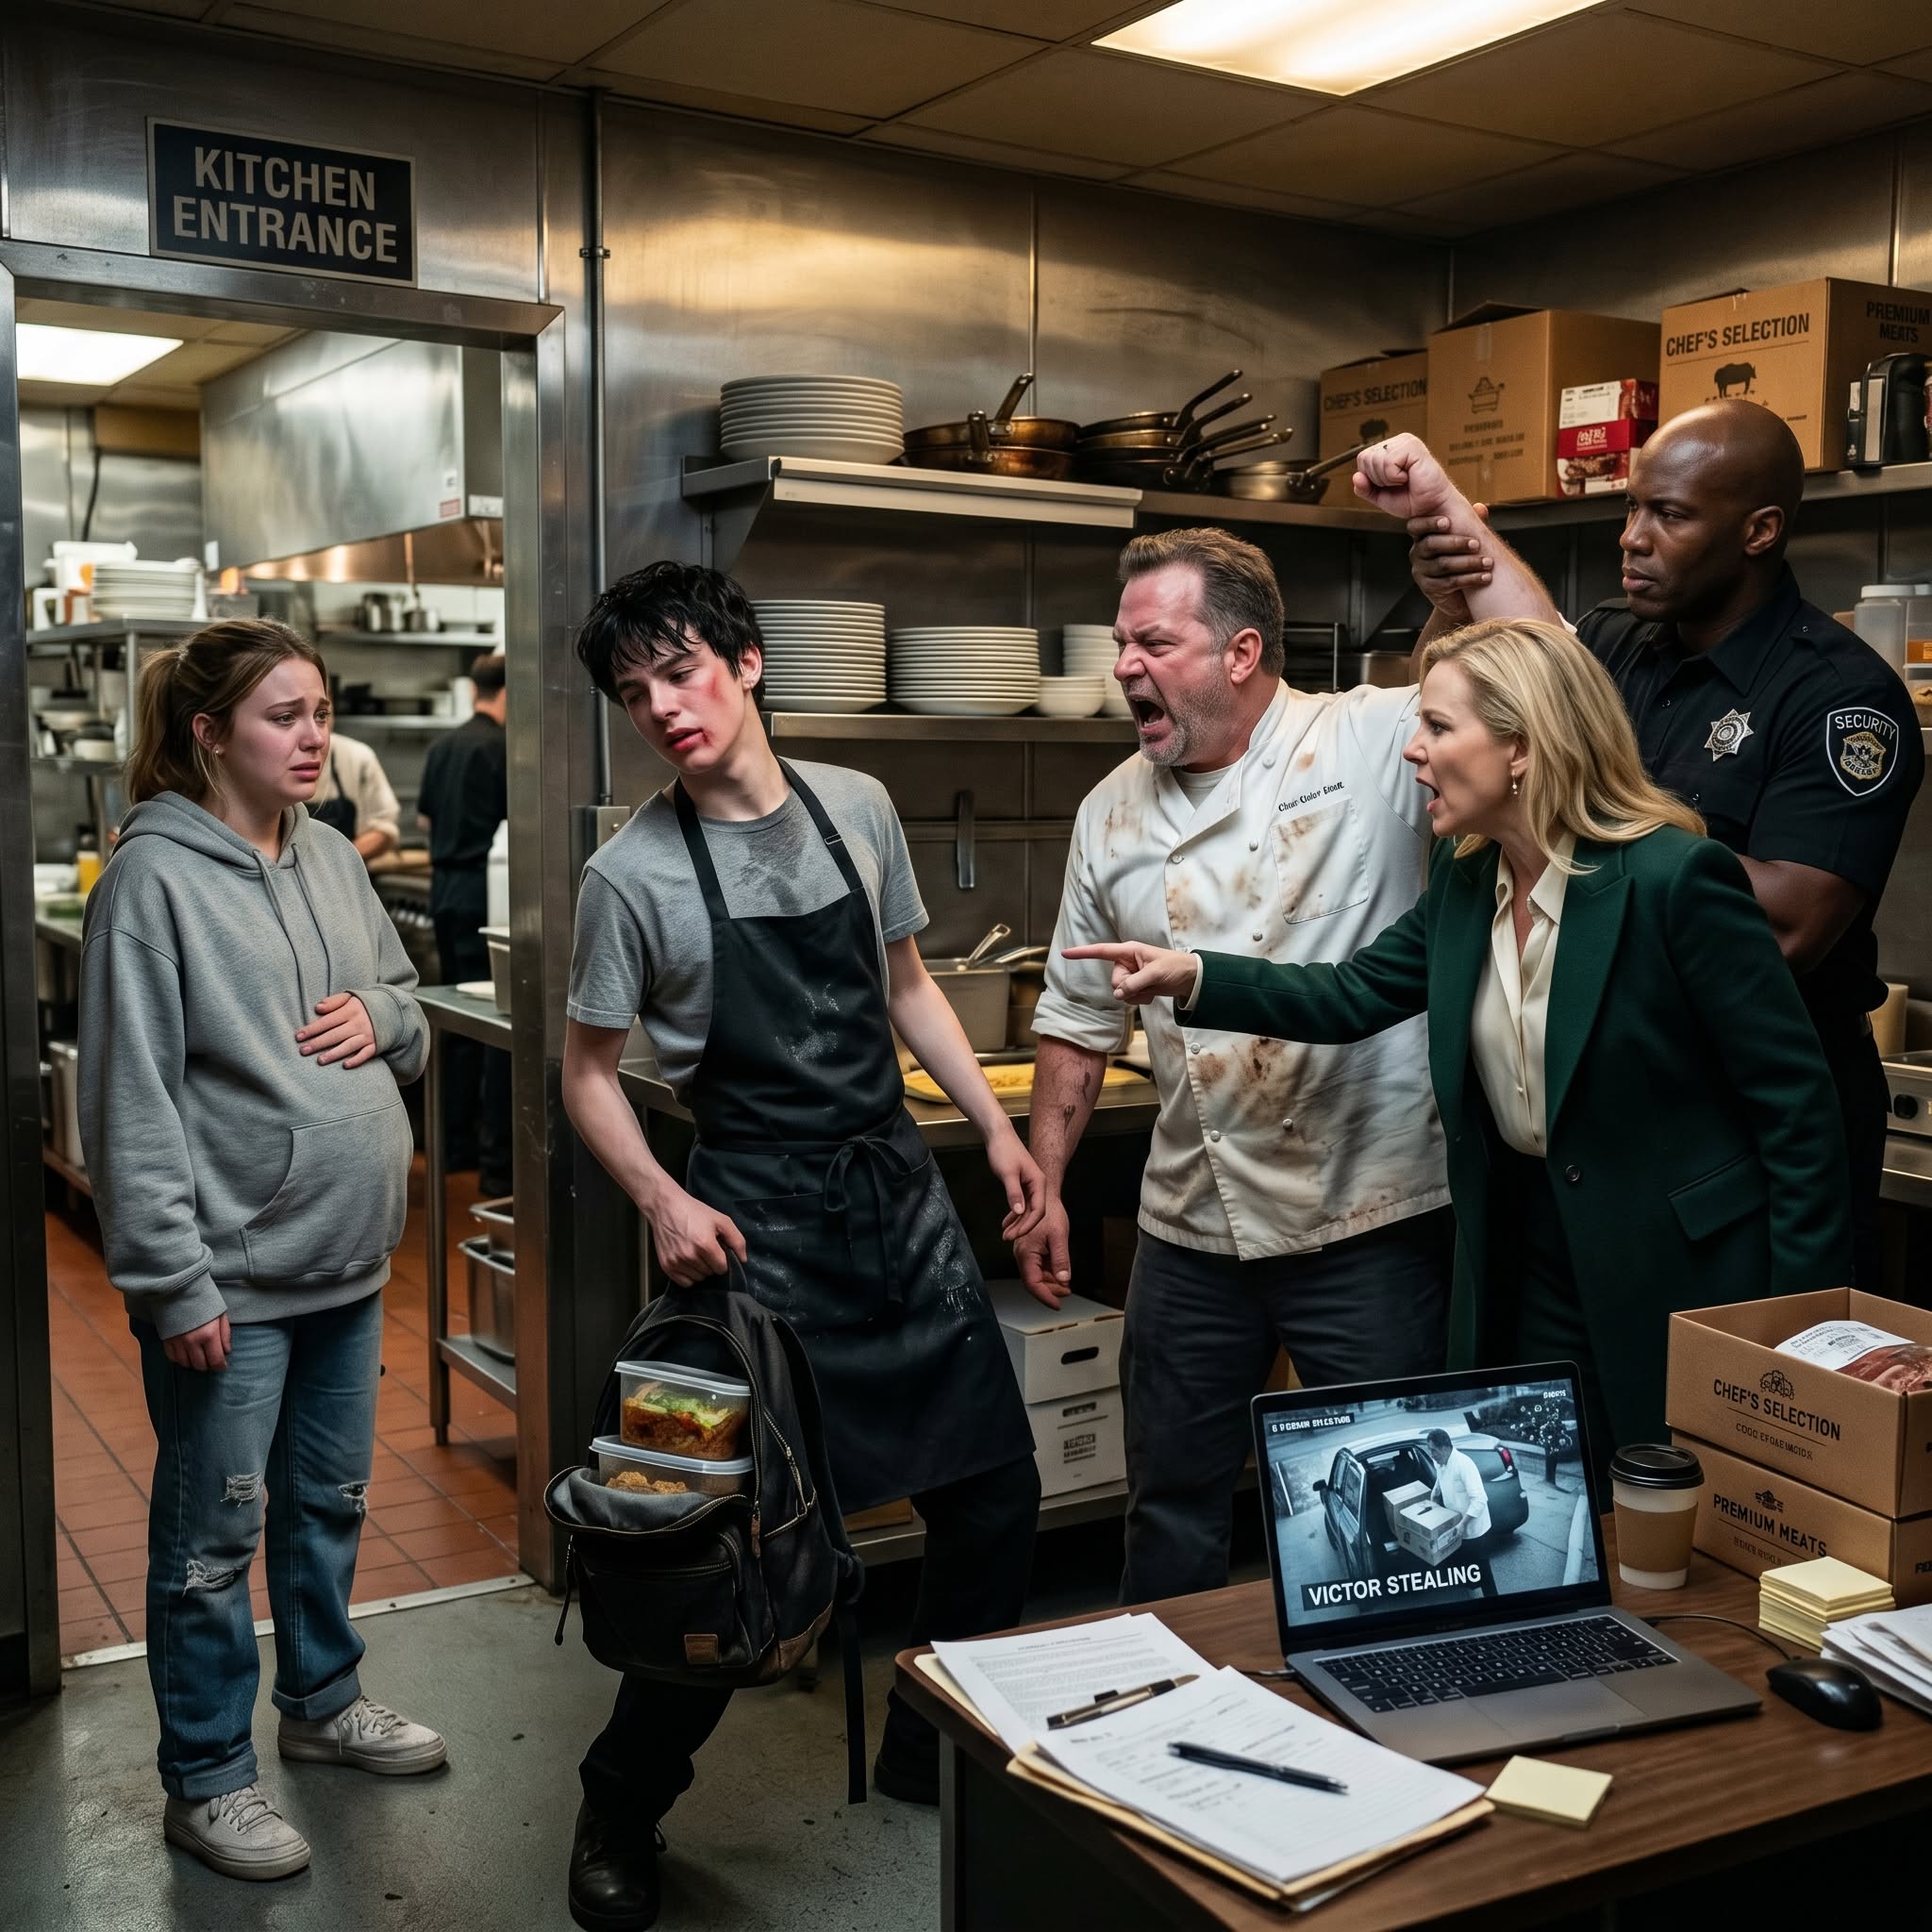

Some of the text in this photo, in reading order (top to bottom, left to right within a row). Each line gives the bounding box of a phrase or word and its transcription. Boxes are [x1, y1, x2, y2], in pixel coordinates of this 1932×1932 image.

[194, 146, 375, 211] KITCHEN
[174, 195, 397, 263] ENTRANCE
[1666, 312, 1810, 358] CHEF'S SELECTION
[1866, 301, 1930, 325] PREMIUM
[1878, 323, 1919, 343] MEATS
[1324, 377, 1427, 412] CHEF'S SELECTION
[1834, 714, 1896, 741] SECURITY
[1713, 1378, 1840, 1441] CHEF'S SELECTION
[1713, 1493, 1775, 1536] PREMIUM
[1779, 1523, 1827, 1557] MEATS
[1308, 1563, 1482, 1606] VICTOR STEALING
